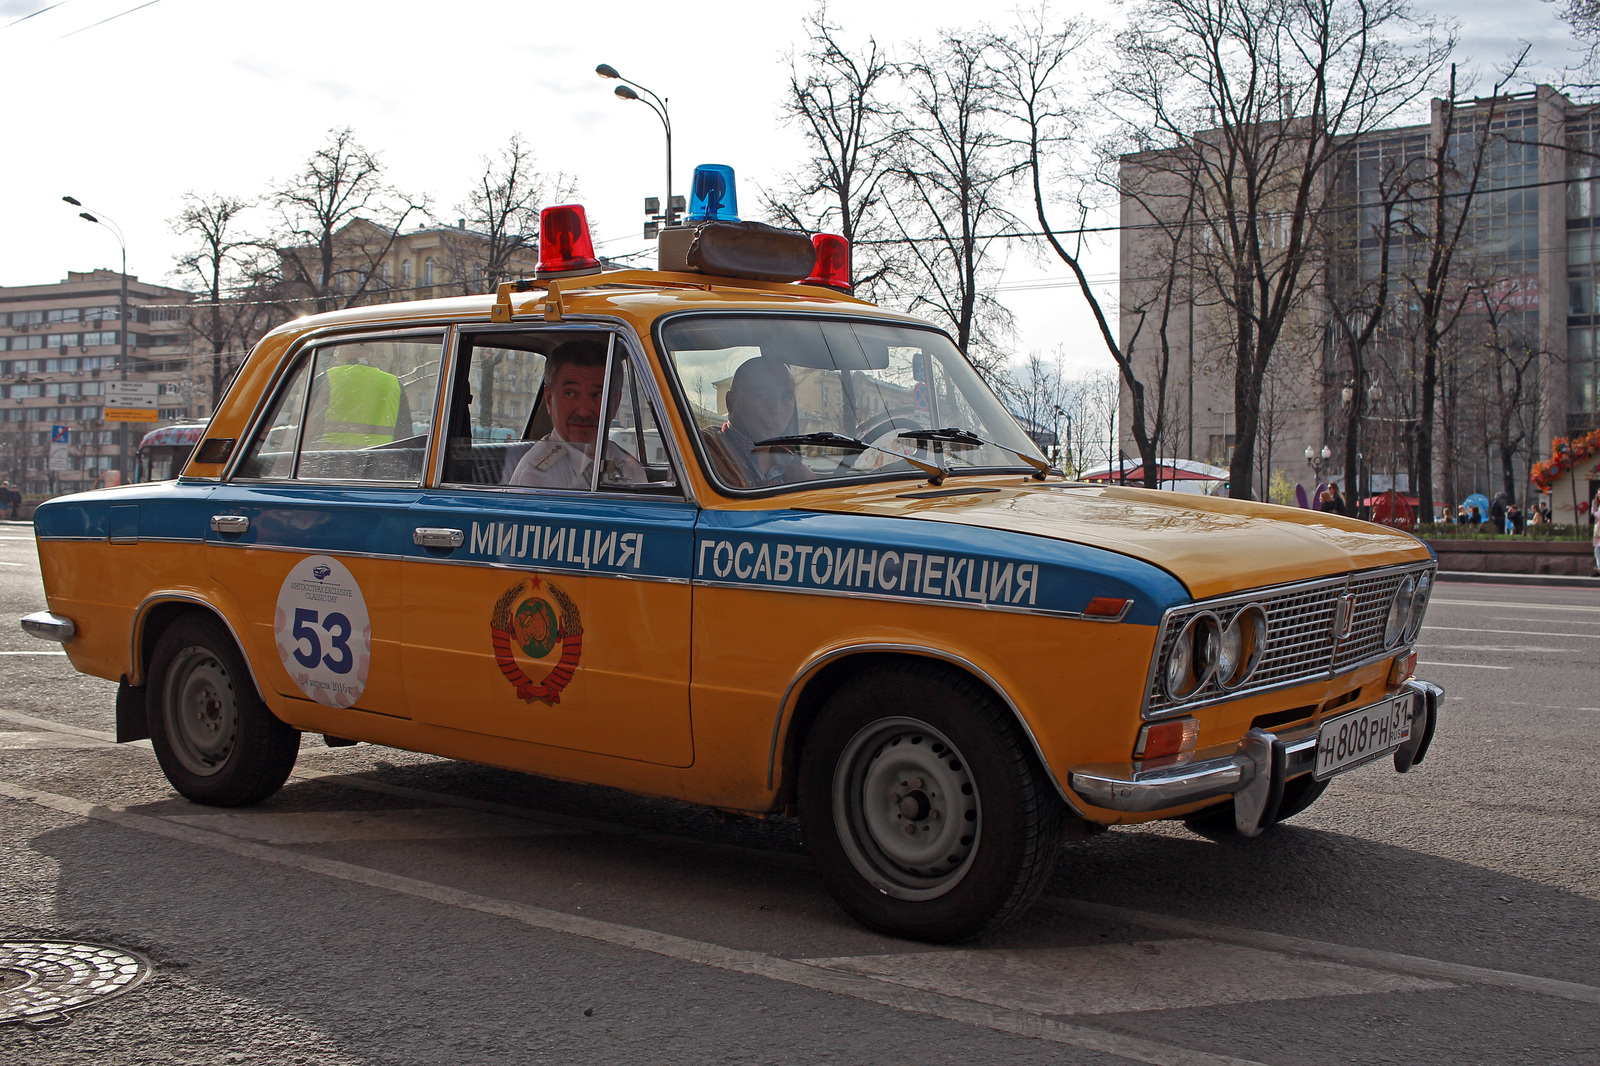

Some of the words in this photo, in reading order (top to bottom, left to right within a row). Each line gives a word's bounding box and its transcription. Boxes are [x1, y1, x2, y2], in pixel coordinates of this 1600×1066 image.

[470, 521, 643, 569] МИЛИЦИЯ
[699, 540, 1039, 605] ГОСАВТОИНСПЕКЦИЯ
[305, 592, 326, 602] CLASSIC
[327, 595, 338, 604] DAY
[325, 586, 353, 597] EXCLUSIVE
[292, 608, 353, 674] 53
[309, 680, 331, 690] апреля
[1393, 699, 1409, 728] 31
[1391, 729, 1401, 740] RUS
